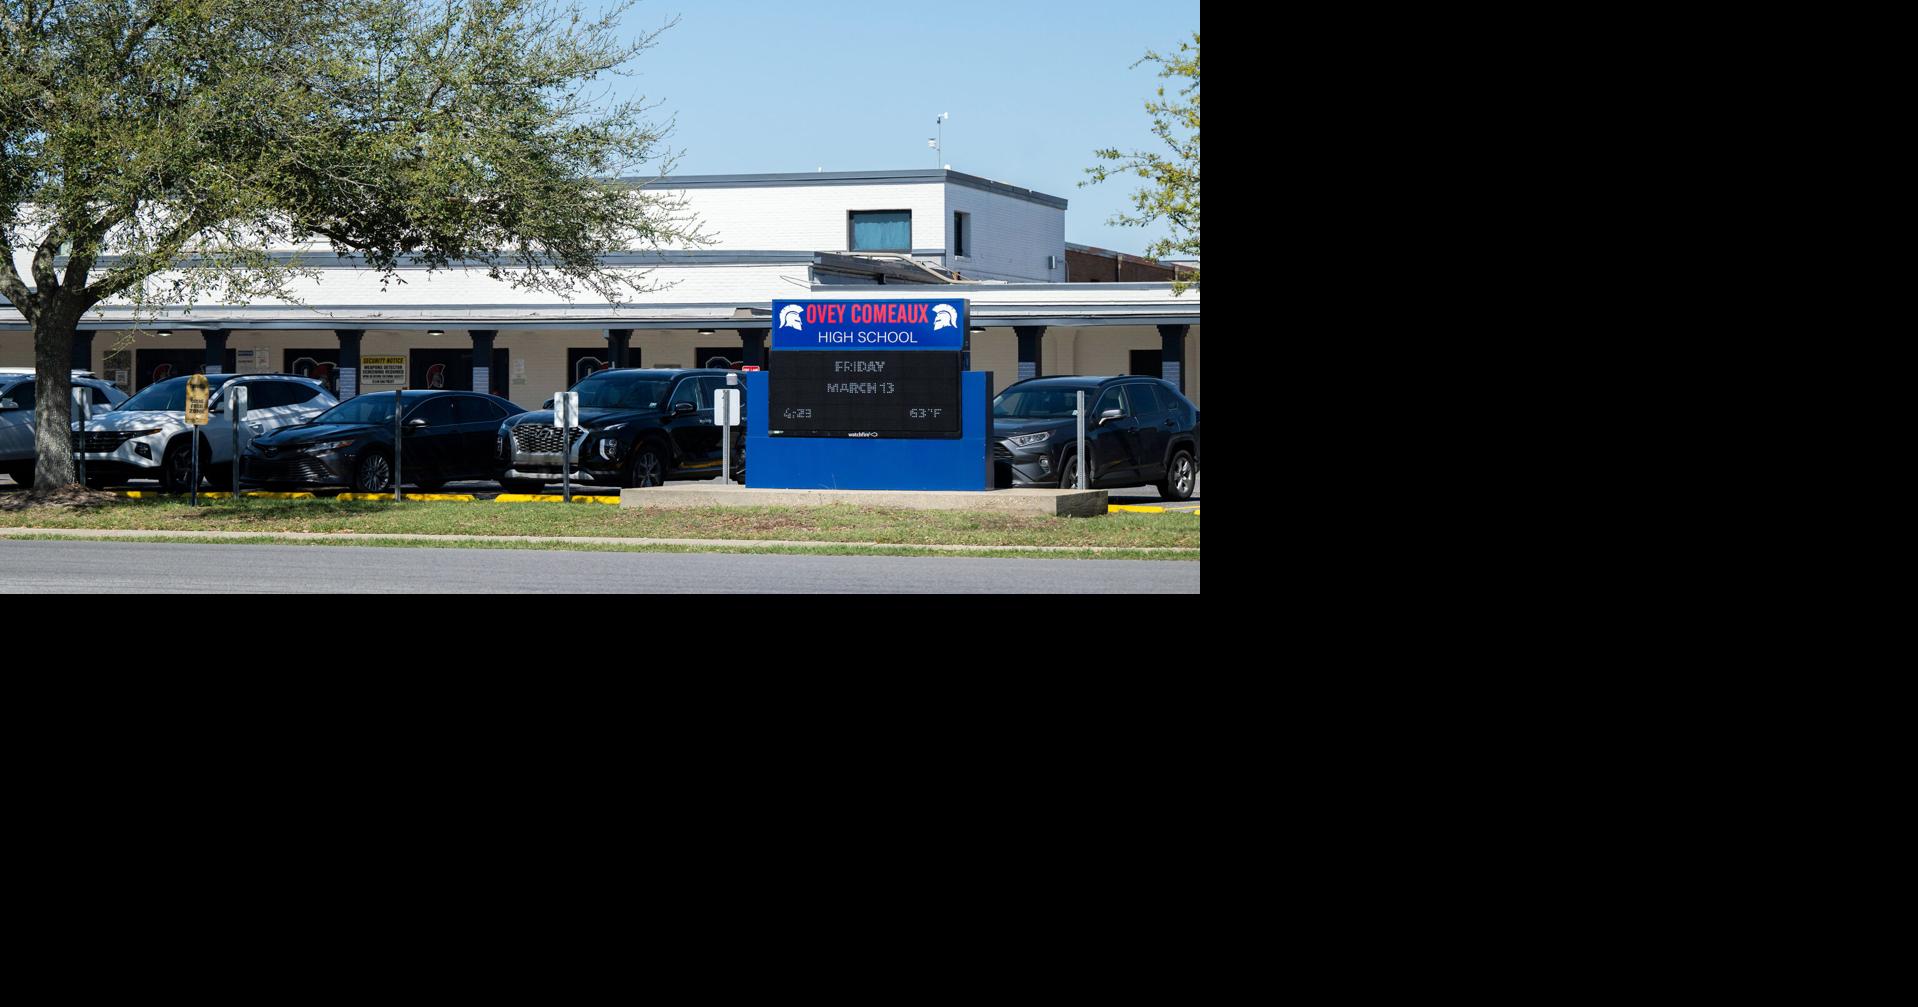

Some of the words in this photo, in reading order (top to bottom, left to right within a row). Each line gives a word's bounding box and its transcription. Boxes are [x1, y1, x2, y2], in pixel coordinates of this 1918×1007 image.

[806, 303, 846, 324] OVEY
[851, 303, 929, 324] COMEAUX
[818, 331, 853, 343] HIGH
[857, 331, 918, 343] SCHOOL
[834, 361, 886, 372] FRIDAY
[827, 382, 877, 394] MARCH
[879, 382, 895, 394] 13
